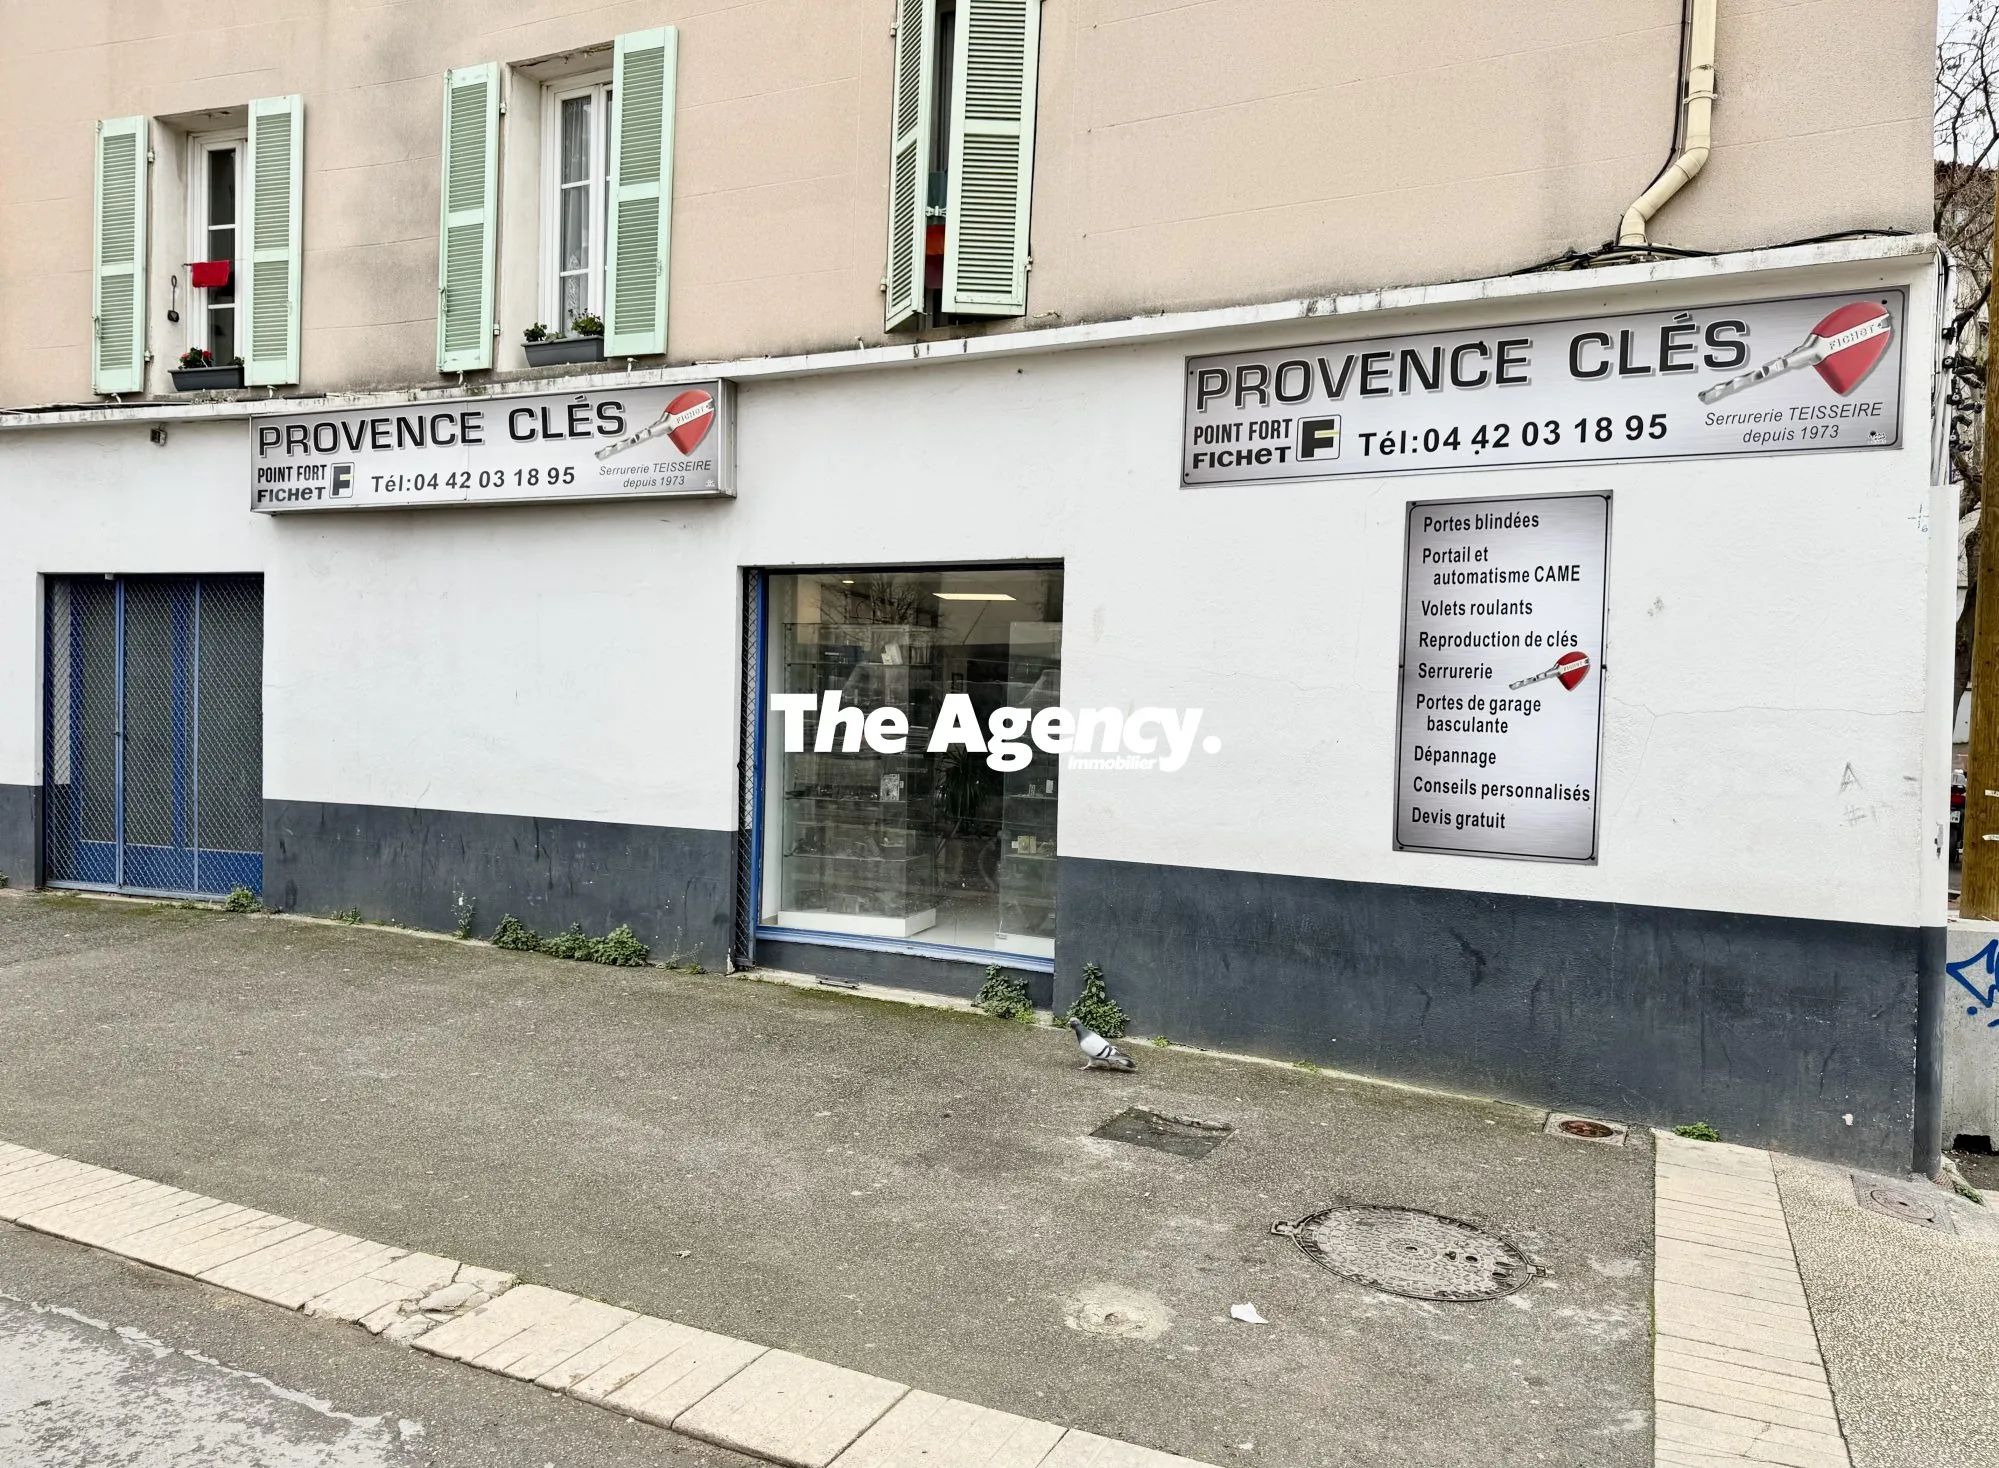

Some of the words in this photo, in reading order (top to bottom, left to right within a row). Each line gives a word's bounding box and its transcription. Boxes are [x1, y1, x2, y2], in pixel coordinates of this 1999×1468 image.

[1195, 338, 1533, 413] PROVENCE
[1567, 311, 1751, 382] CLÉS
[1704, 407, 1784, 427] Serrurerie
[1788, 402, 1884, 422] TEISSEIRE
[258, 411, 484, 458] PROVENCE
[508, 394, 626, 442] CLÉS
[1193, 422, 1244, 446] POINT
[1248, 418, 1293, 442] FORT
[1471, 422, 1511, 449] 42
[1521, 419, 1562, 446] 03
[1573, 416, 1614, 443] 18
[1625, 413, 1668, 441] 95
[1742, 429, 1796, 446] depuis
[1801, 424, 1840, 441] 1973
[257, 466, 293, 484] POINT
[296, 464, 327, 482] FORT
[445, 471, 472, 489] 42
[478, 469, 505, 488] 03
[513, 468, 540, 486] 18
[547, 466, 575, 485] 95
[599, 463, 649, 476] Serrurerie
[652, 460, 712, 473] TEISSEIRE
[623, 478, 657, 490] depuis
[660, 476, 685, 487] 1973
[1424, 516, 1471, 532] Portes
[1475, 511, 1540, 530] blindées
[1422, 547, 1471, 564] Portail
[1474, 547, 1489, 562] et
[1433, 567, 1530, 585] automatisme
[1534, 565, 1581, 582] CAME
[1421, 600, 1466, 616] Volets
[1470, 599, 1533, 615] roulants
[1419, 631, 1520, 651] Reproduction
[1524, 631, 1543, 647] de
[1546, 631, 1578, 647] clés
[1418, 663, 1493, 679] Serrurerie
[1416, 694, 1463, 710] Portes
[1467, 694, 1485, 710] de
[1489, 698, 1541, 716] garage
[1427, 716, 1509, 733] basculante
[1414, 745, 1497, 768] Dépannage
[1413, 776, 1477, 795] Conseils
[1481, 783, 1590, 801] personnalisés
[1412, 807, 1452, 825] Devis
[1456, 811, 1506, 830] gratuit
